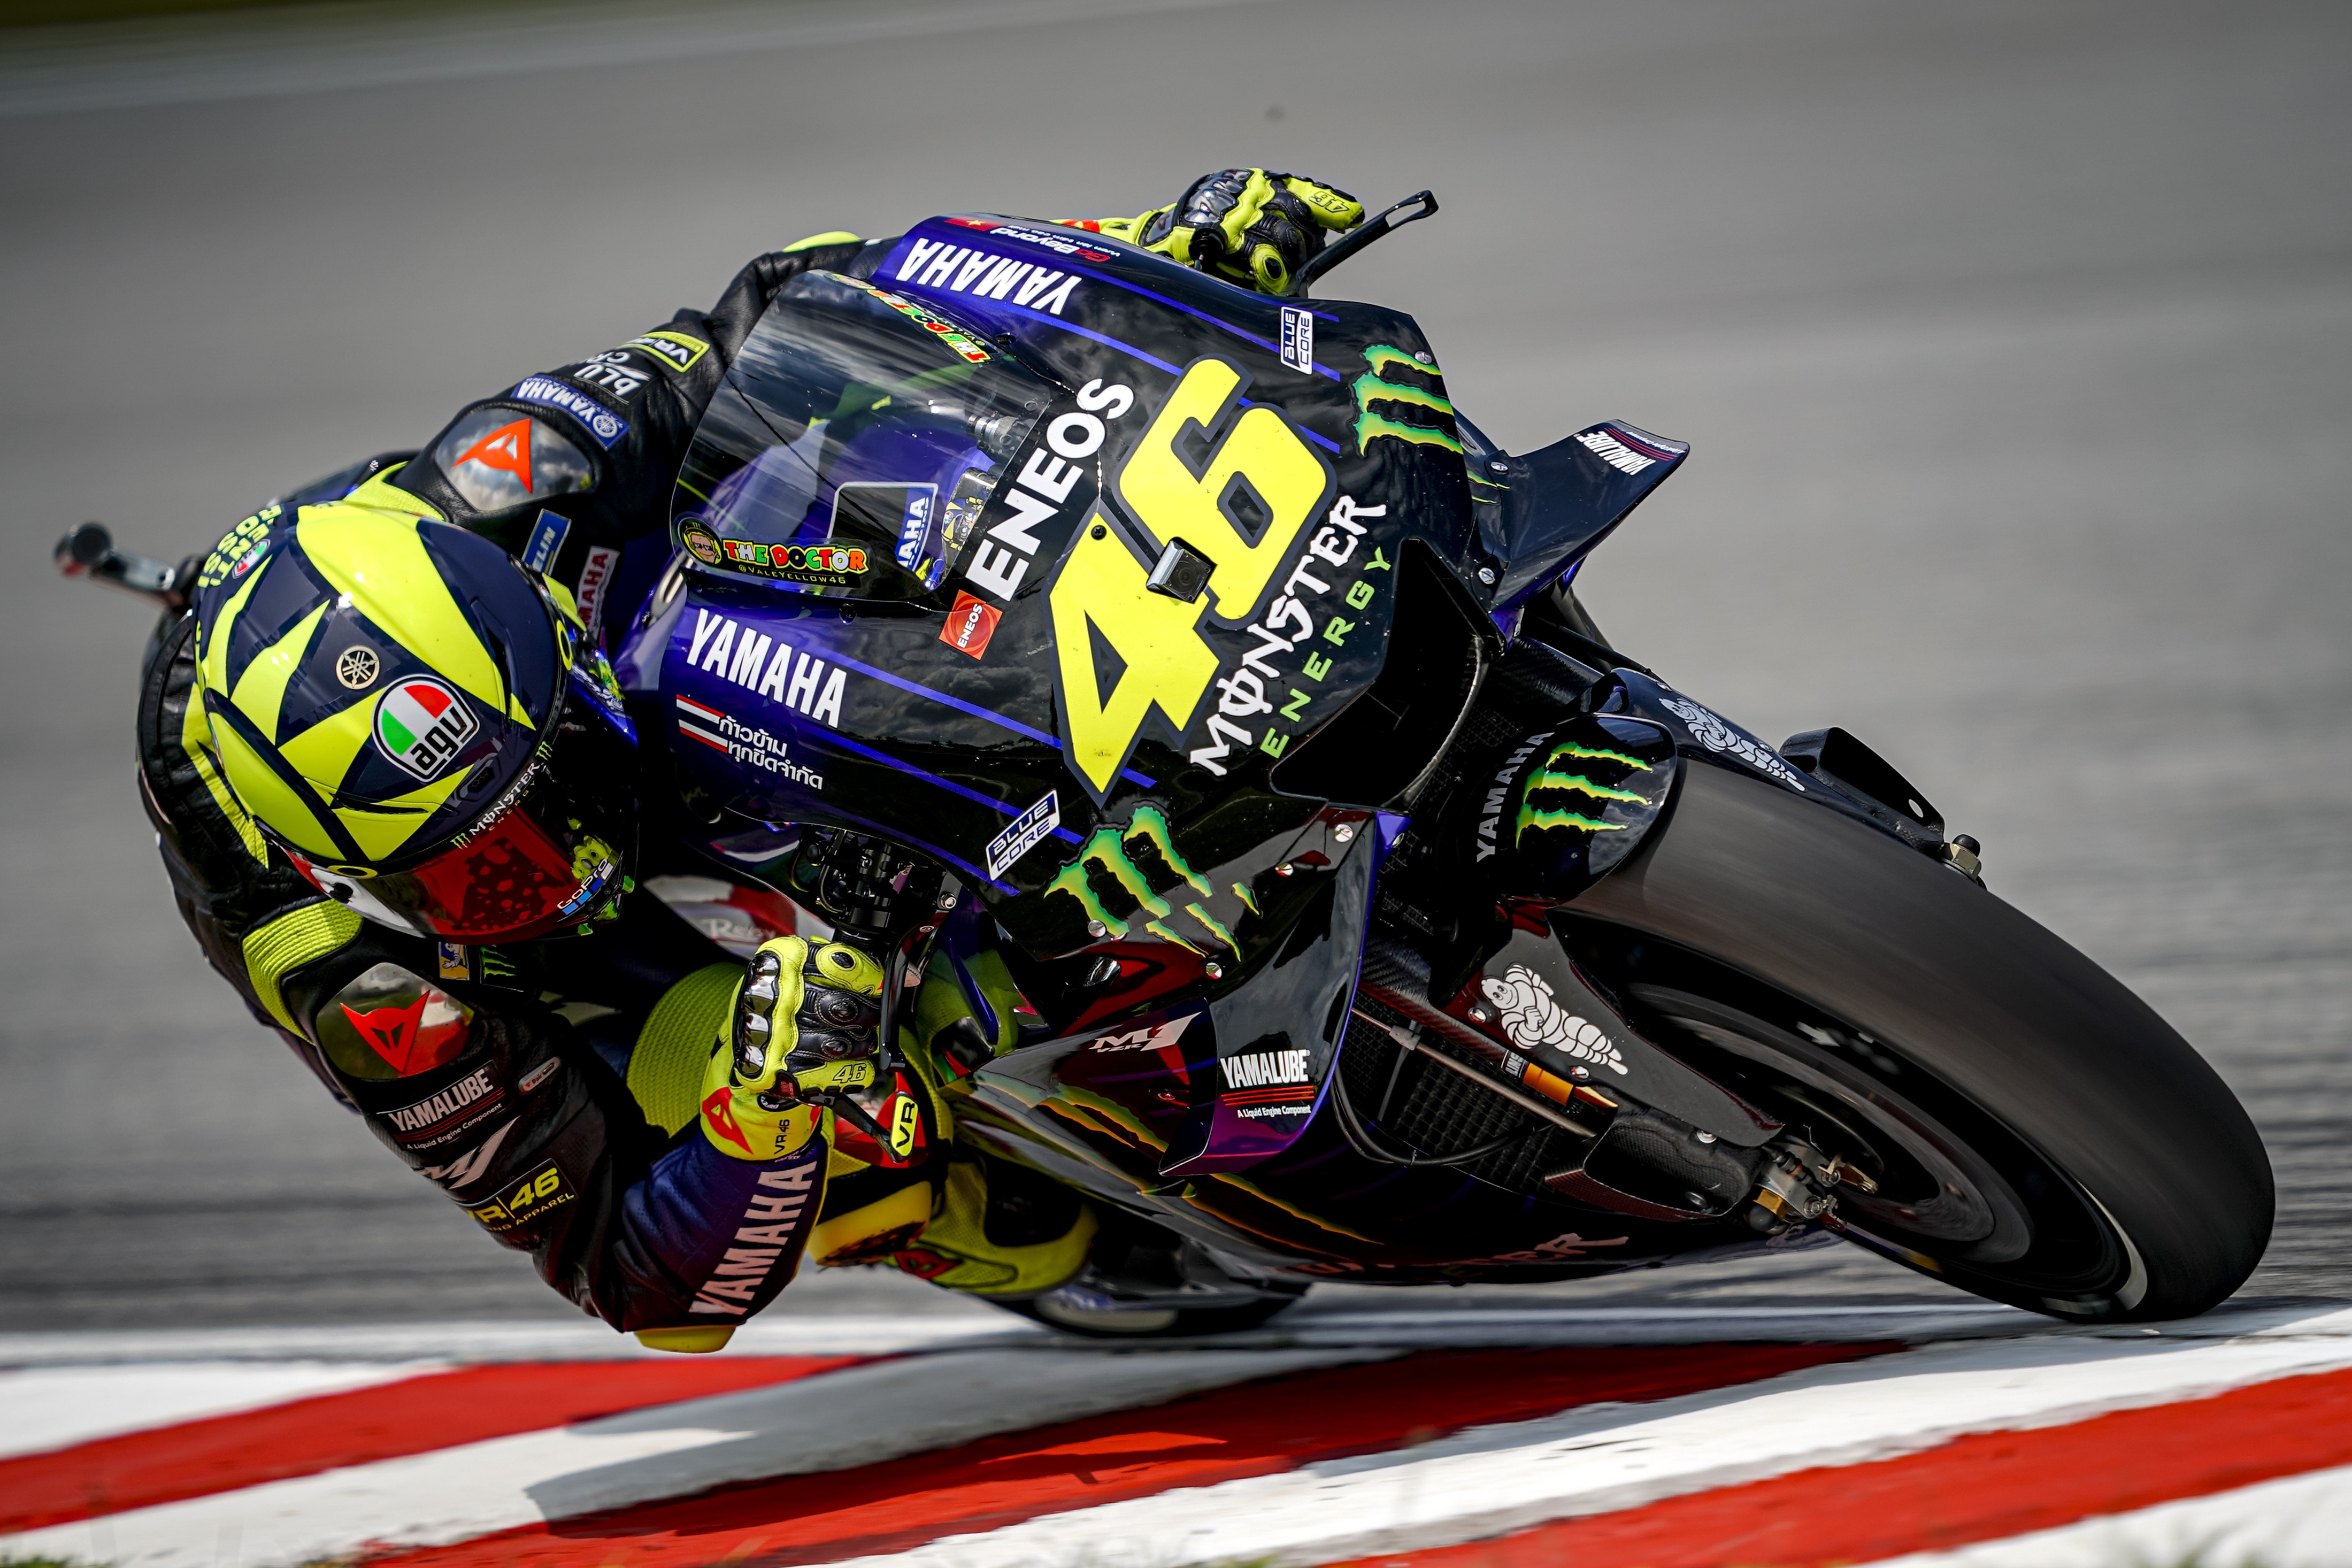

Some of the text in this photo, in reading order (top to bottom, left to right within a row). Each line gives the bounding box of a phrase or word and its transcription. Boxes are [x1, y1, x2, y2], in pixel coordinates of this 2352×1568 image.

[1309, 189, 1350, 213] 46
[895, 238, 1082, 314] YAMAHA
[936, 332, 991, 364] THE
[1284, 312, 1296, 360] BLUE
[1300, 316, 1310, 366] CORE
[517, 382, 596, 422] YAMAHA
[1576, 431, 1656, 475] YAMALUBE
[966, 378, 1134, 602] ENEOS
[533, 526, 556, 572] ELIN
[723, 539, 869, 575] THE DOCTOR
[898, 497, 926, 567] AHA
[578, 552, 610, 626] MAHA
[738, 564, 846, 585] @VALEYELLOW46
[1048, 358, 1327, 795] 46
[957, 602, 983, 649] ENEOS
[1189, 495, 1387, 777] MONSTER
[686, 608, 847, 729] YAMAHA
[1260, 546, 1392, 759] ENERGY
[410, 706, 467, 771] agv
[719, 715, 788, 758] ก้าวข้าม
[469, 763, 540, 835] MONSTER
[488, 781, 535, 831] ENERGY
[1477, 732, 1556, 863] YAMAHA
[991, 800, 1049, 856] BLUE
[995, 818, 1054, 872] CORE
[557, 858, 608, 909] GoPro
[1089, 1011, 1203, 1051] M1
[833, 1063, 867, 1083] 46
[1220, 1049, 1310, 1089] YAMALUBE
[388, 1068, 494, 1132] YAMALUBE
[1237, 1105, 1311, 1119] A Liquid Engine Component
[413, 1139, 437, 1150] Liquid
[437, 1127, 462, 1143] Engine
[462, 1103, 503, 1130] Component
[516, 1193, 575, 1226] APPAREL
[689, 1159, 817, 1316] YAMAHA
